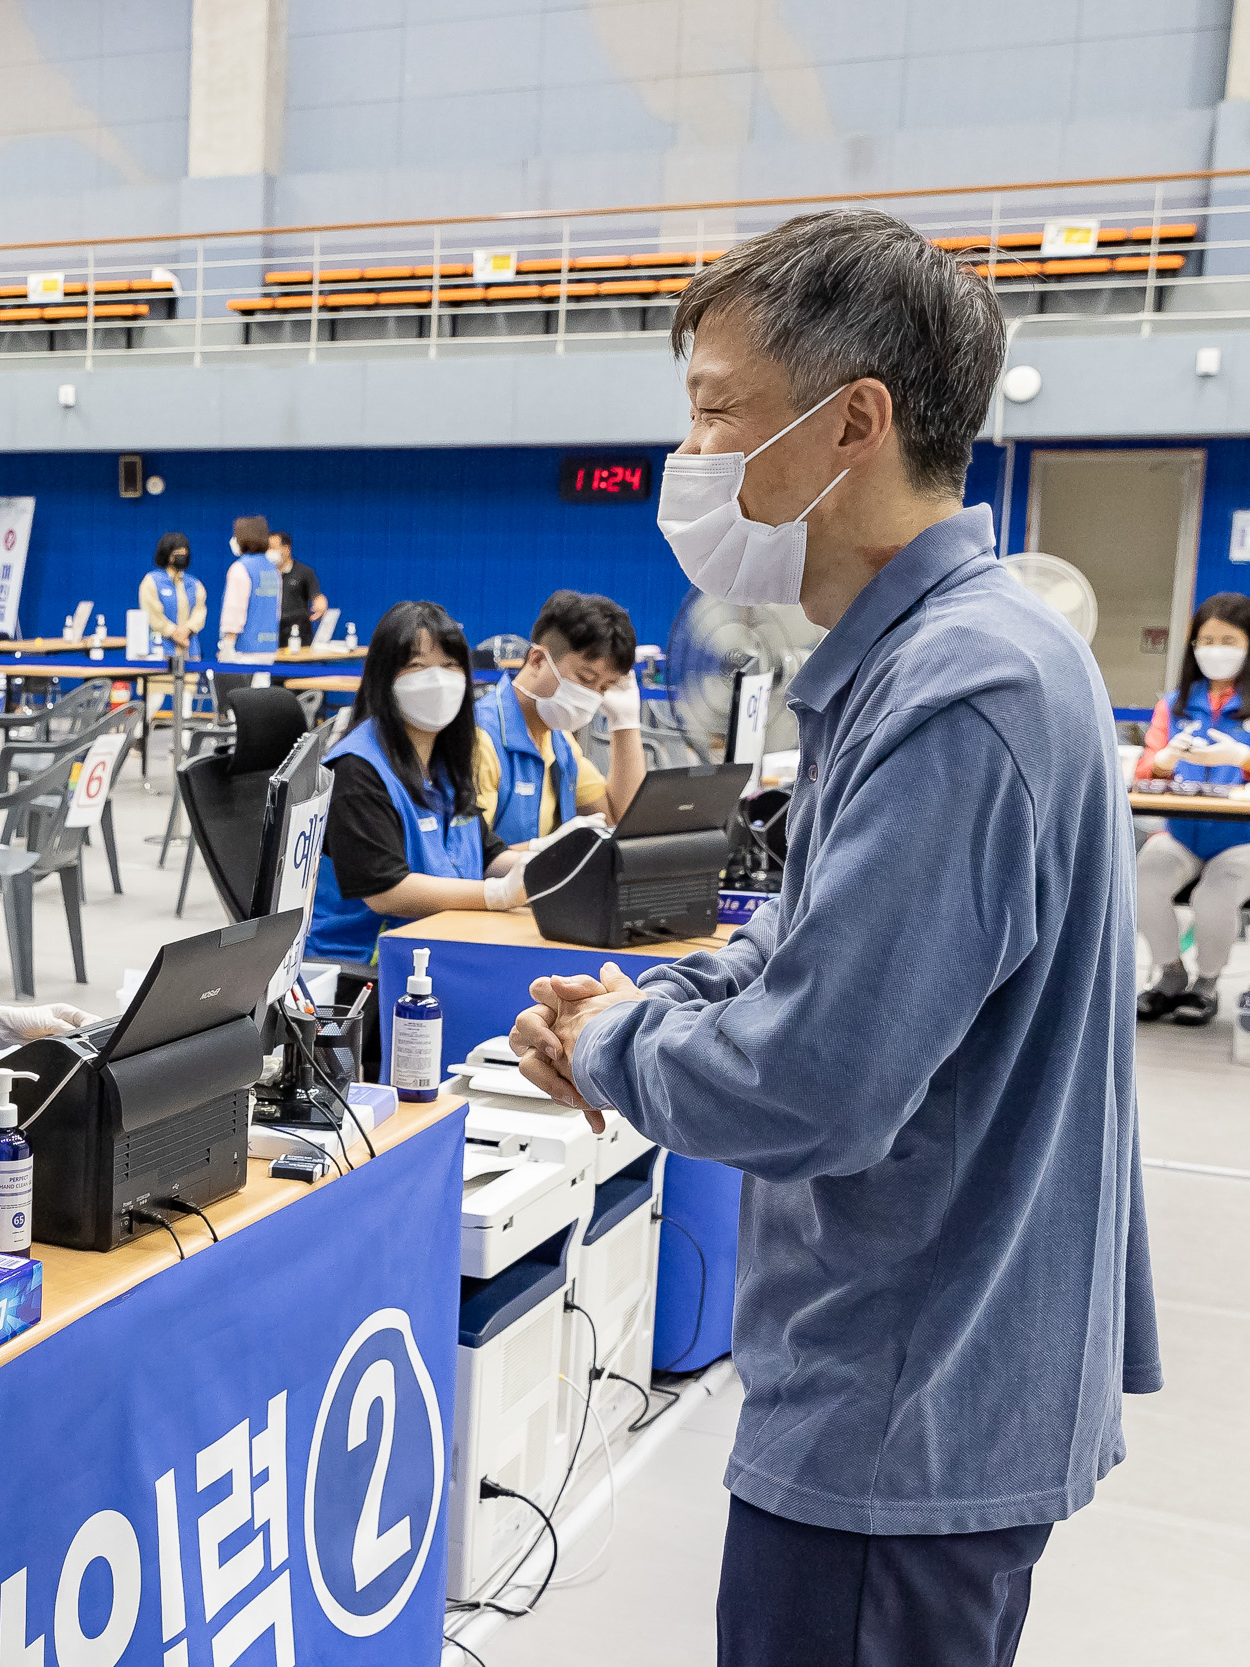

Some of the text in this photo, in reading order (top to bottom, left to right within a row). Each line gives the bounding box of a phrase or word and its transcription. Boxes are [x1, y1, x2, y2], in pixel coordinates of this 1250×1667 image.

[576, 466, 642, 492] 11:24
[86, 761, 106, 799] 6
[200, 987, 222, 1000] EPSON
[14, 1215, 24, 1225] 65
